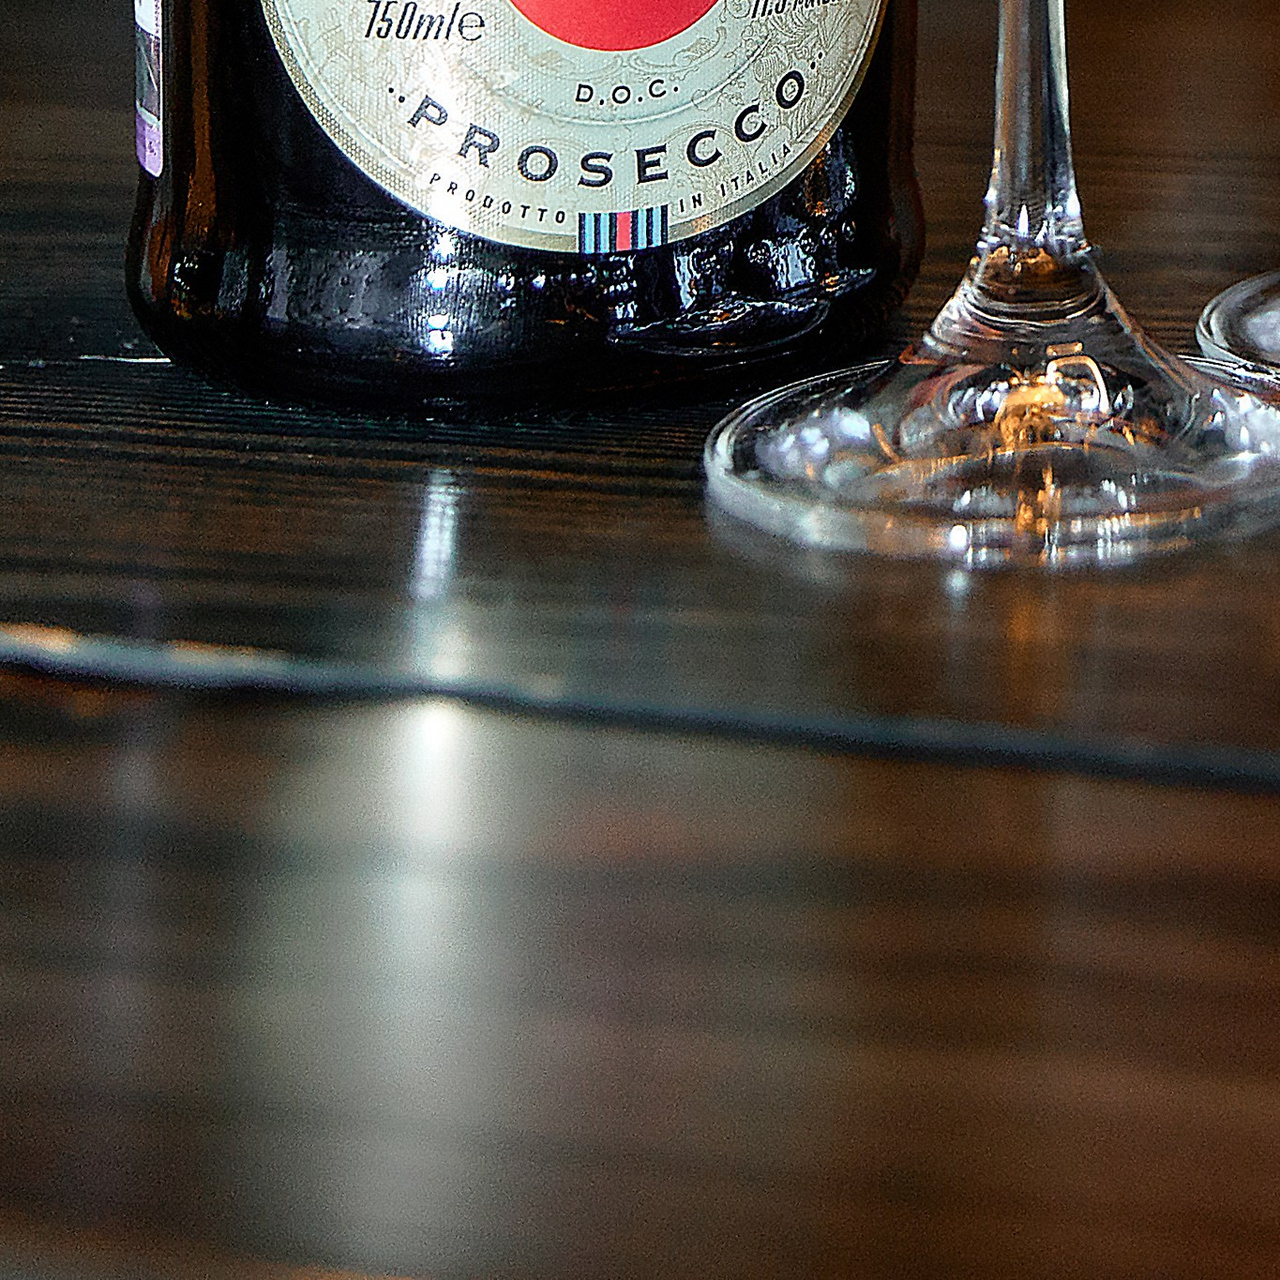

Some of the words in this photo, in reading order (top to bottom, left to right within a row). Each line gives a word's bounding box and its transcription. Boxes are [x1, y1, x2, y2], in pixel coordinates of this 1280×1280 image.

[407, 70, 805, 187] PROSECCO
[575, 79, 678, 105] D.O.C.
[430, 173, 565, 223] PRODOTTO
[679, 193, 702, 212] IN
[720, 144, 791, 196] ITALIA
